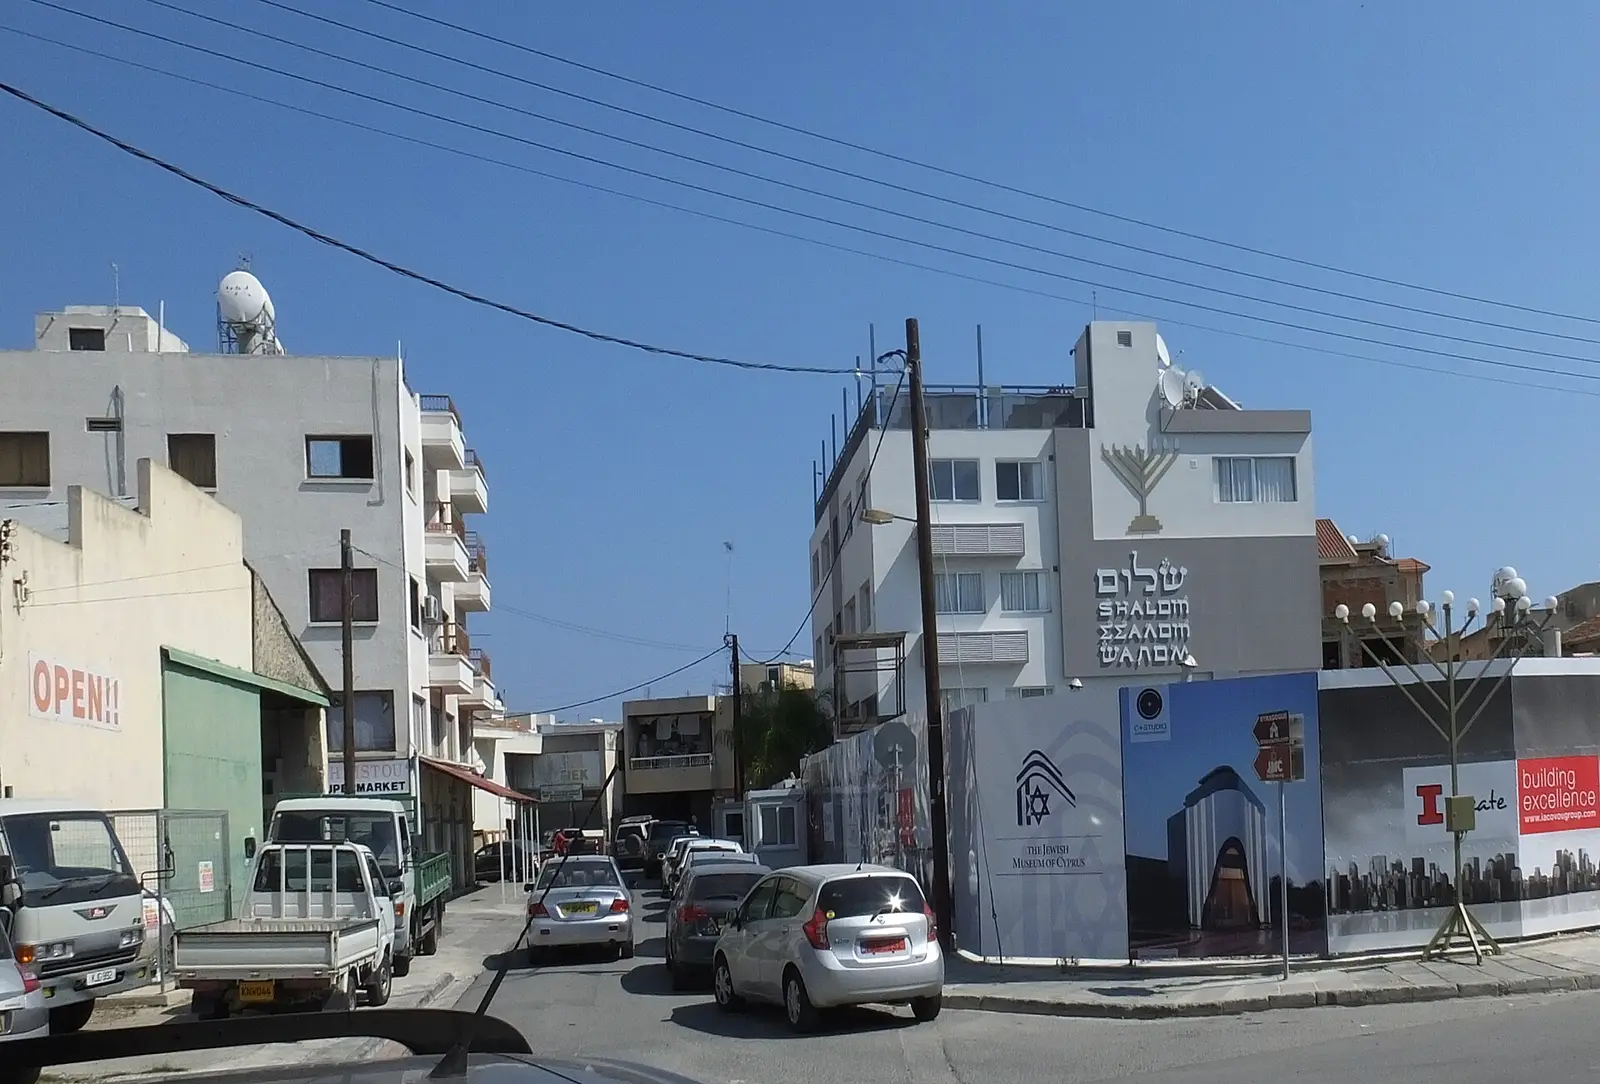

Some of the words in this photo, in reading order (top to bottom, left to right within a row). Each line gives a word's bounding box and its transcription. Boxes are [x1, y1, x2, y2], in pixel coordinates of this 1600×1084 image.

[1096, 550, 1188, 593] שלום
[1098, 597, 1190, 616] SHALOM
[33, 659, 119, 725] OPEN!!
[356, 781, 406, 793] MARKET
[1522, 767, 1576, 790] building
[1523, 789, 1597, 812] excellence
[1027, 845, 1042, 856] THE
[1042, 843, 1070, 857] JEWISH
[1012, 857, 1045, 869] MUSEUM
[1045, 858, 1056, 868] OF
[1056, 856, 1086, 868] CYPRUS
